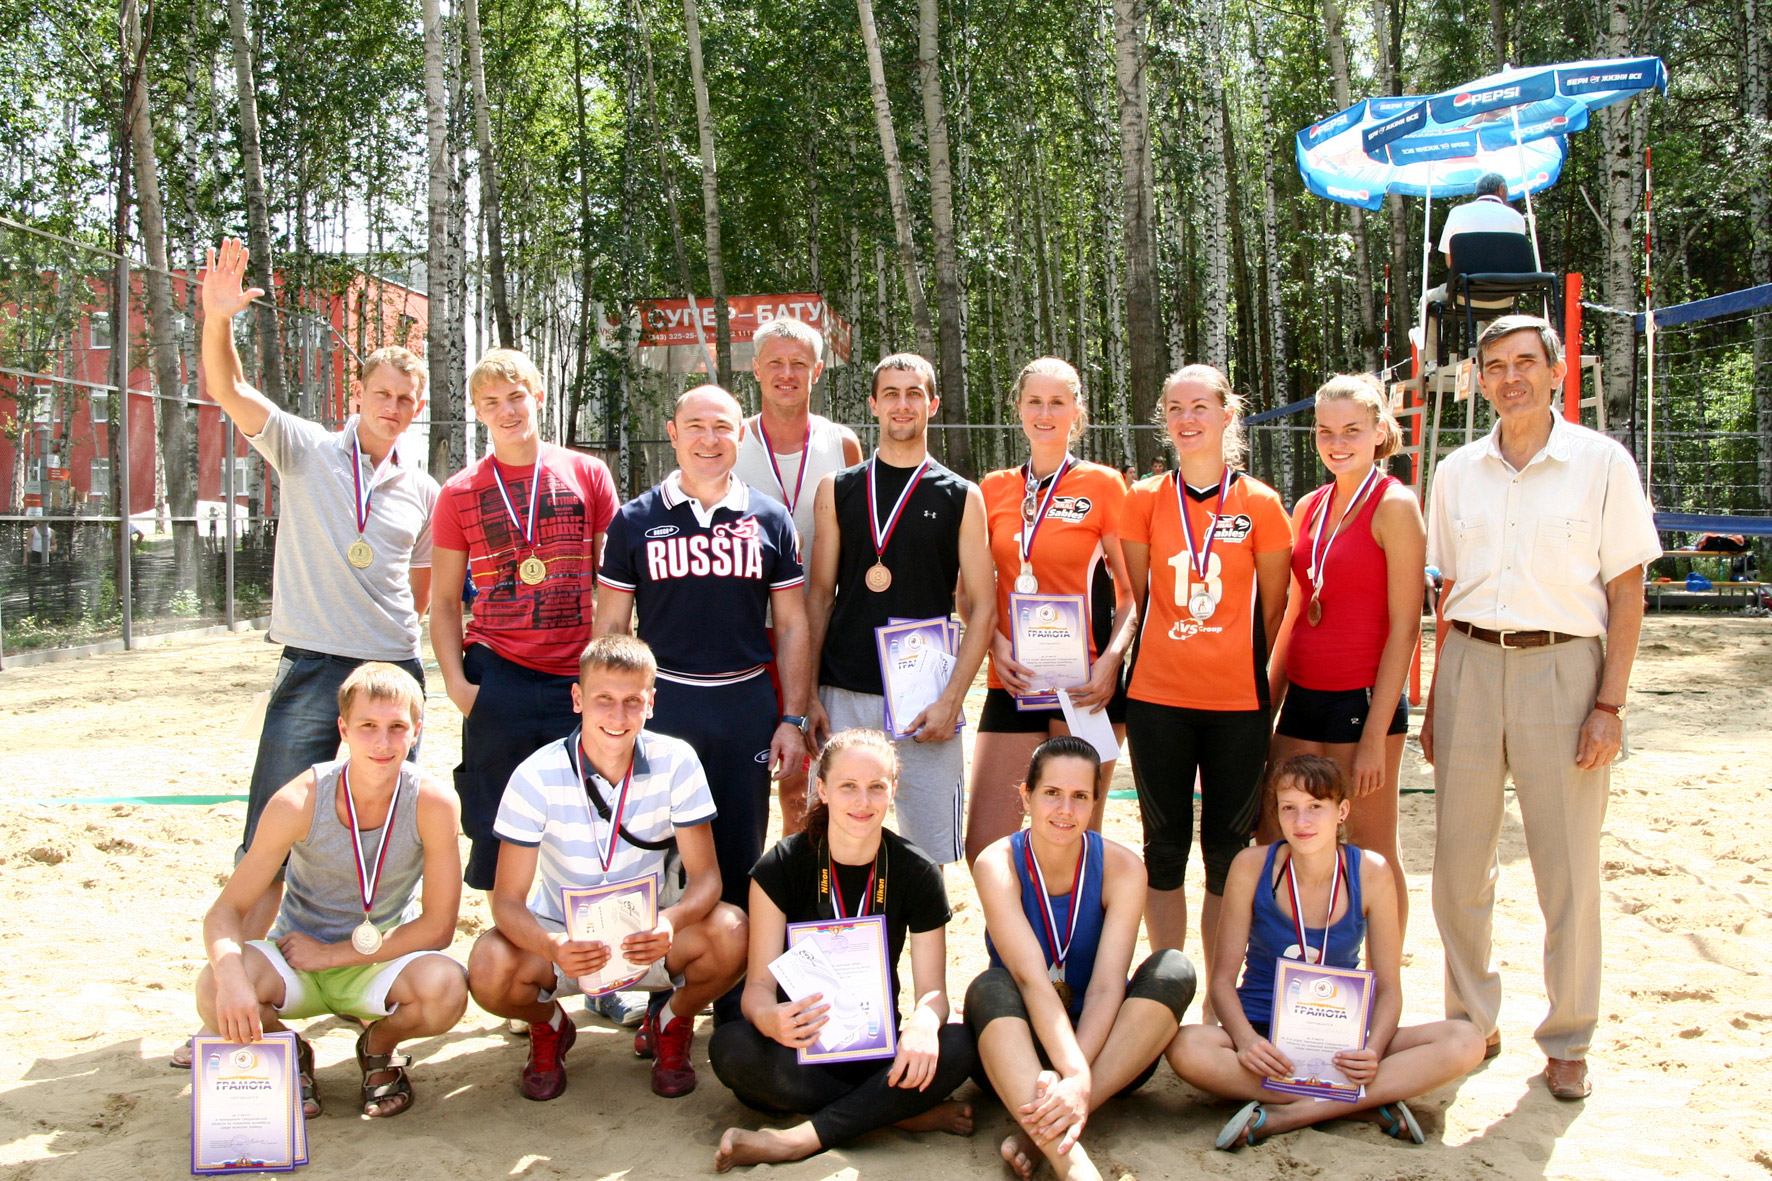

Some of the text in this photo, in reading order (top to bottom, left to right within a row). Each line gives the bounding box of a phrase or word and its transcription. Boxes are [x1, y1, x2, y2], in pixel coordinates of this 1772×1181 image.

[1566, 78, 1588, 86] БЕРИ
[1601, 73, 1627, 82] ЖИЗНИ
[1628, 72, 1642, 80] ВСЕ
[1471, 86, 1520, 106] PEPSI
[1318, 113, 1348, 133] PEPSI
[1048, 508, 1084, 519] Sables
[1213, 528, 1245, 538] ables
[647, 535, 763, 580] RUSSIA
[1028, 629, 1071, 638] ГРАМОТА
[1199, 626, 1223, 634] Group
[821, 868, 829, 894] Nikon
[876, 878, 885, 904] Nikon
[1294, 1004, 1348, 1020] ГРАМОТА
[216, 1080, 272, 1091] ГРАМОТА
